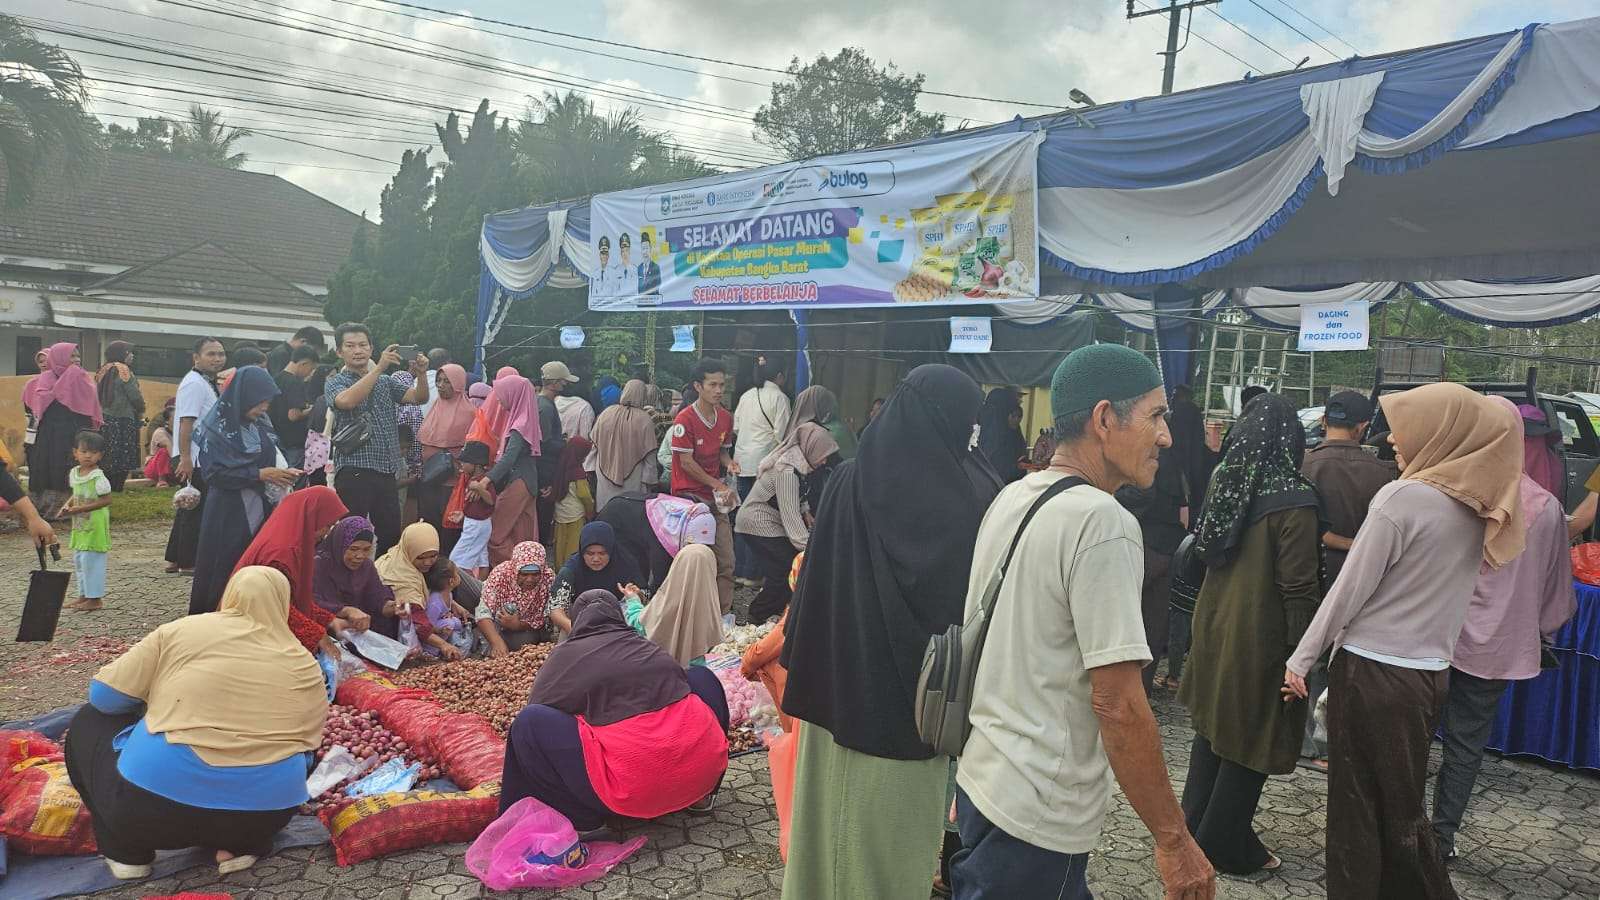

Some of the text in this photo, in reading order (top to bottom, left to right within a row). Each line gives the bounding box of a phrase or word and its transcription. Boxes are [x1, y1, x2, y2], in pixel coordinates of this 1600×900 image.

[829, 170, 868, 189] bulog
[683, 211, 835, 248] SELAMAT DATANG
[693, 281, 818, 304] SELAMAT BERBELANJA
[1318, 310, 1349, 319] DAGING
[1326, 321, 1342, 329] dan
[1304, 331, 1362, 341] FROZEN FOOD
